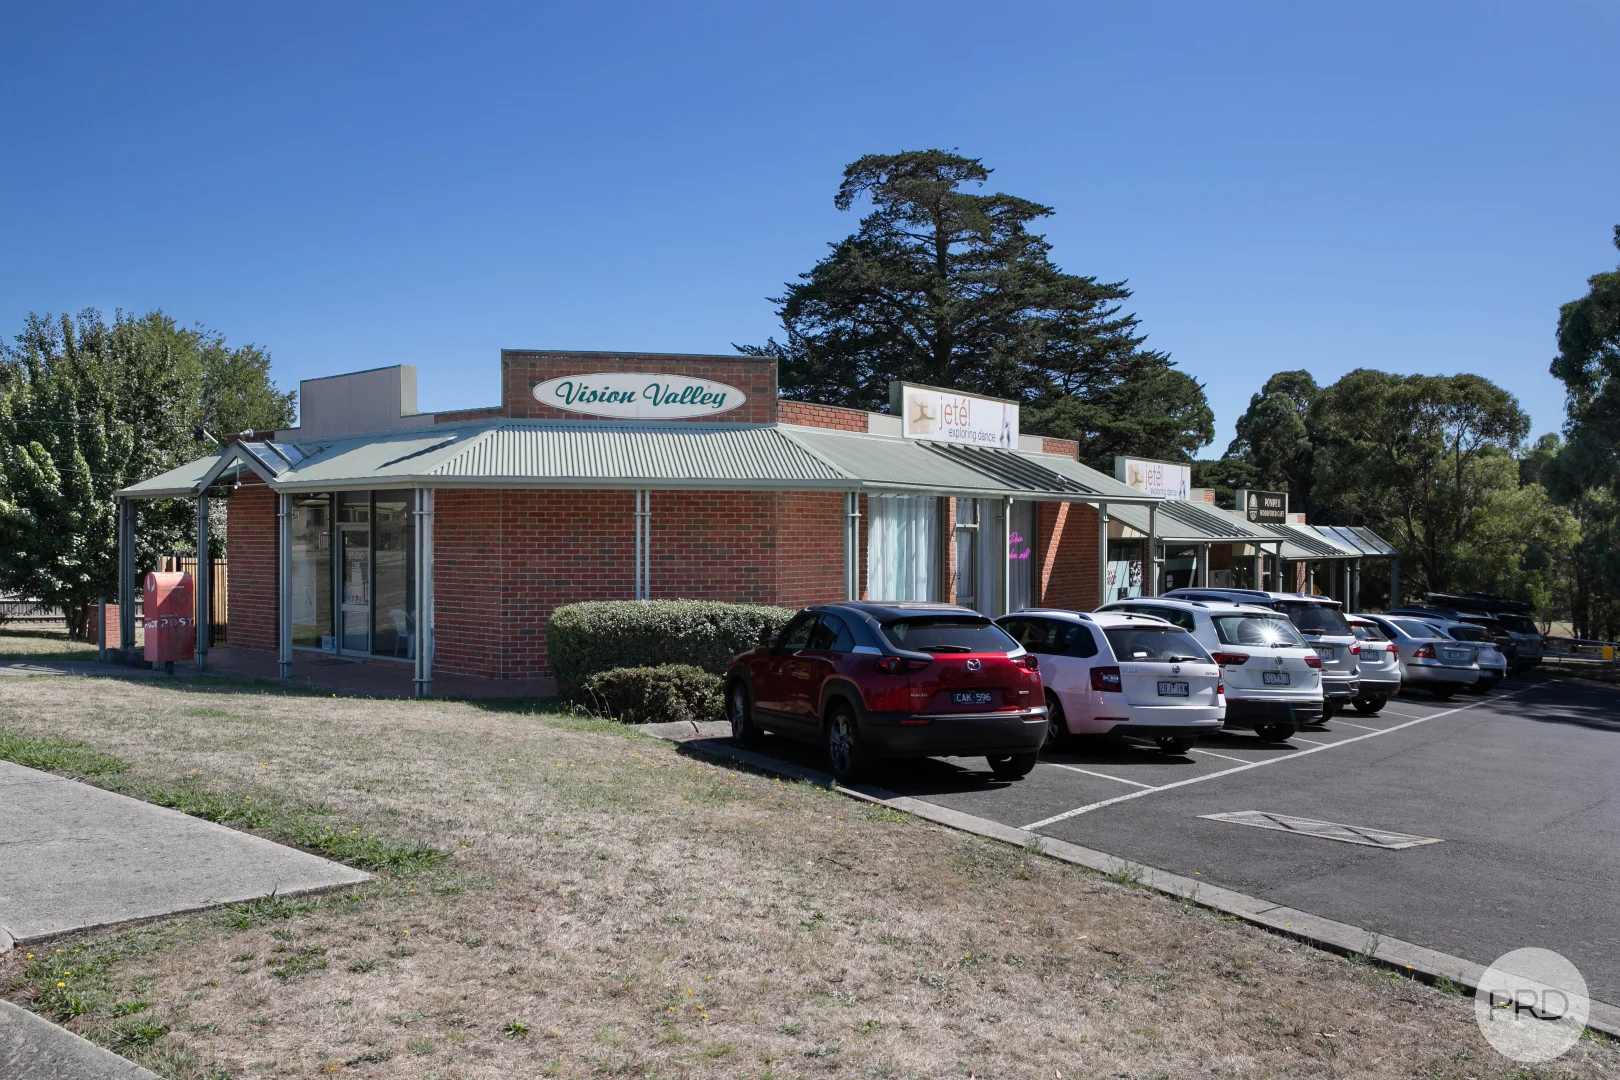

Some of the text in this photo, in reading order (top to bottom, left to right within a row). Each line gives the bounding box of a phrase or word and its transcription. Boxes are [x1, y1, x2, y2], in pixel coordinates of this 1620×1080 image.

[555, 381, 728, 409] Vision Valley
[938, 395, 971, 431] jeté!
[948, 427, 996, 443] exploring dance
[160, 617, 194, 628] POST
